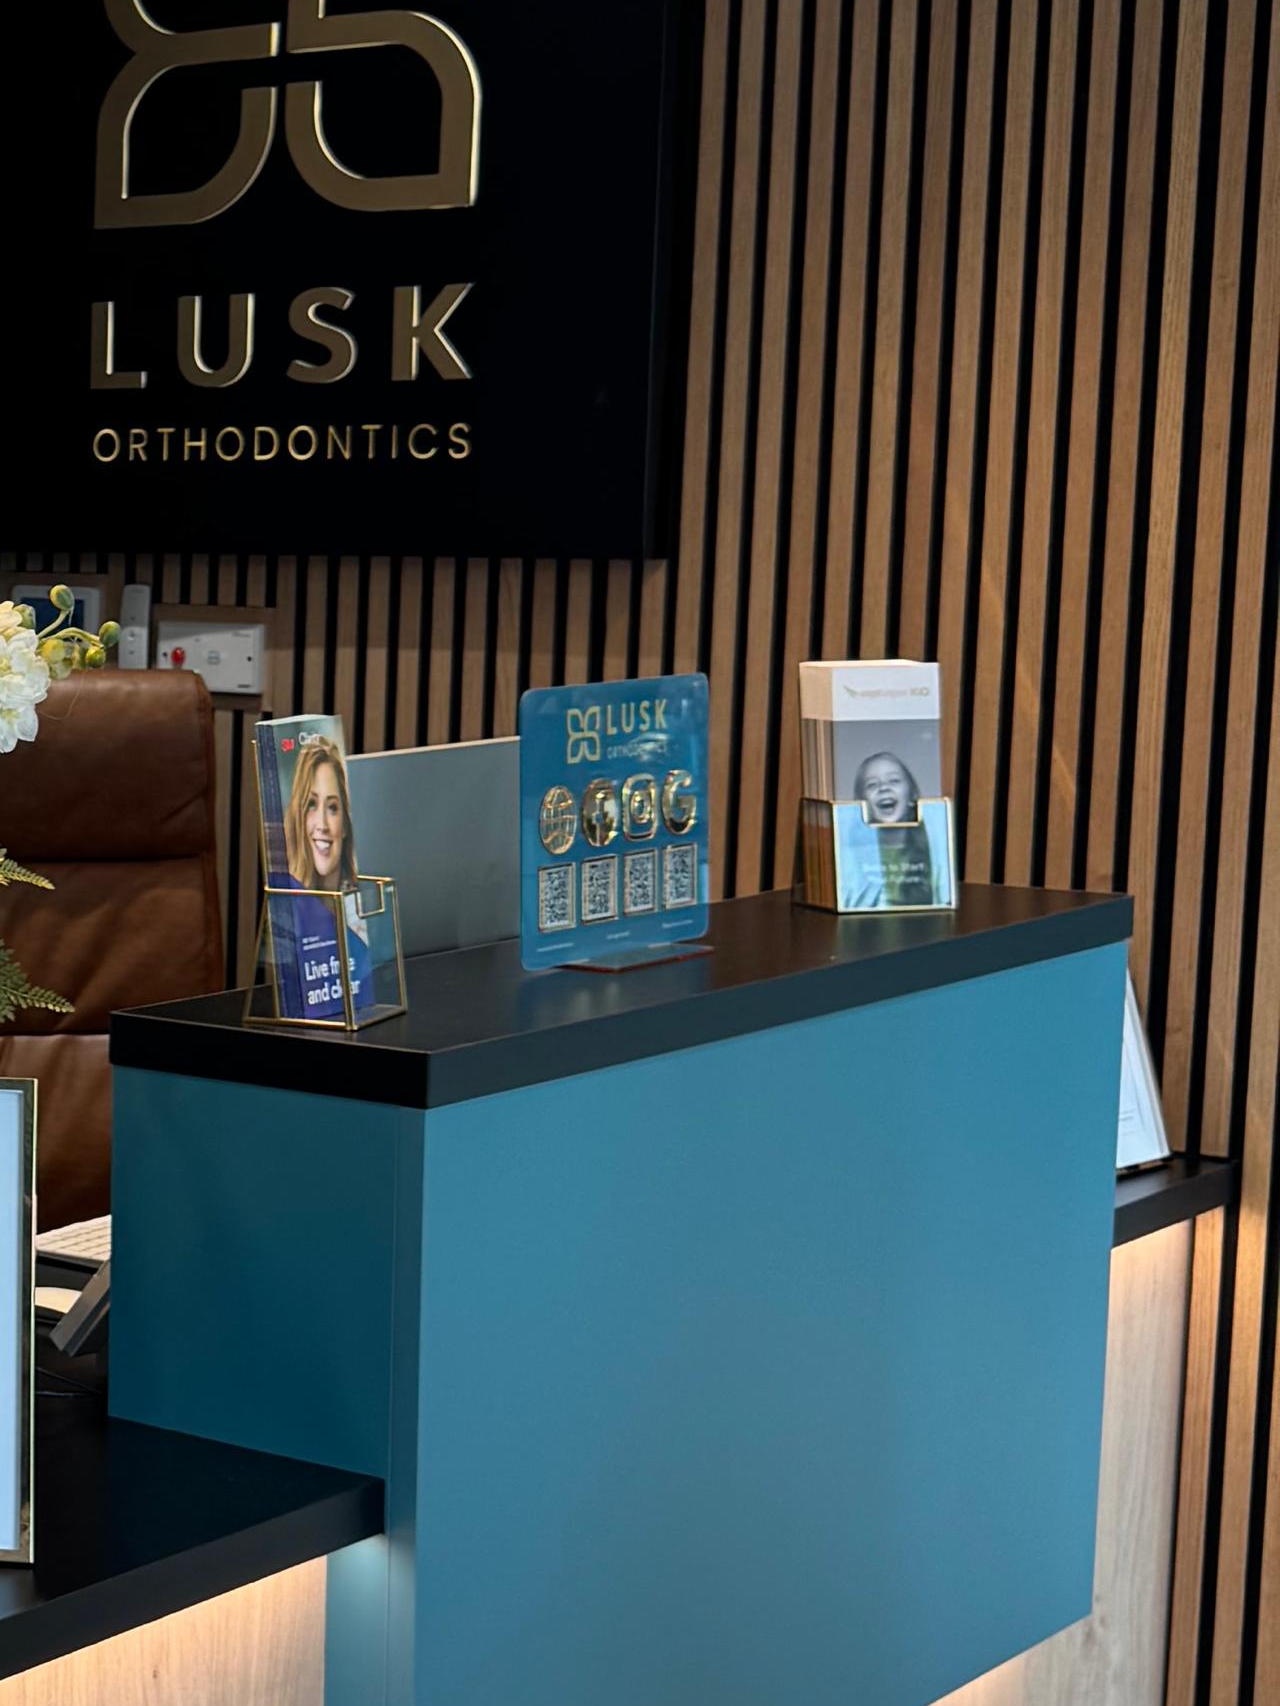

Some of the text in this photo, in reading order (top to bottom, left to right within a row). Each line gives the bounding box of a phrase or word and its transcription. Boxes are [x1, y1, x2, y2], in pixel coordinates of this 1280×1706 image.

[90, 282, 475, 390] LUSK
[92, 422, 473, 463] ORTHODONTICS
[606, 698, 668, 736] LUSK
[304, 955, 356, 982] Live fre
[307, 978, 361, 1006] and clar
